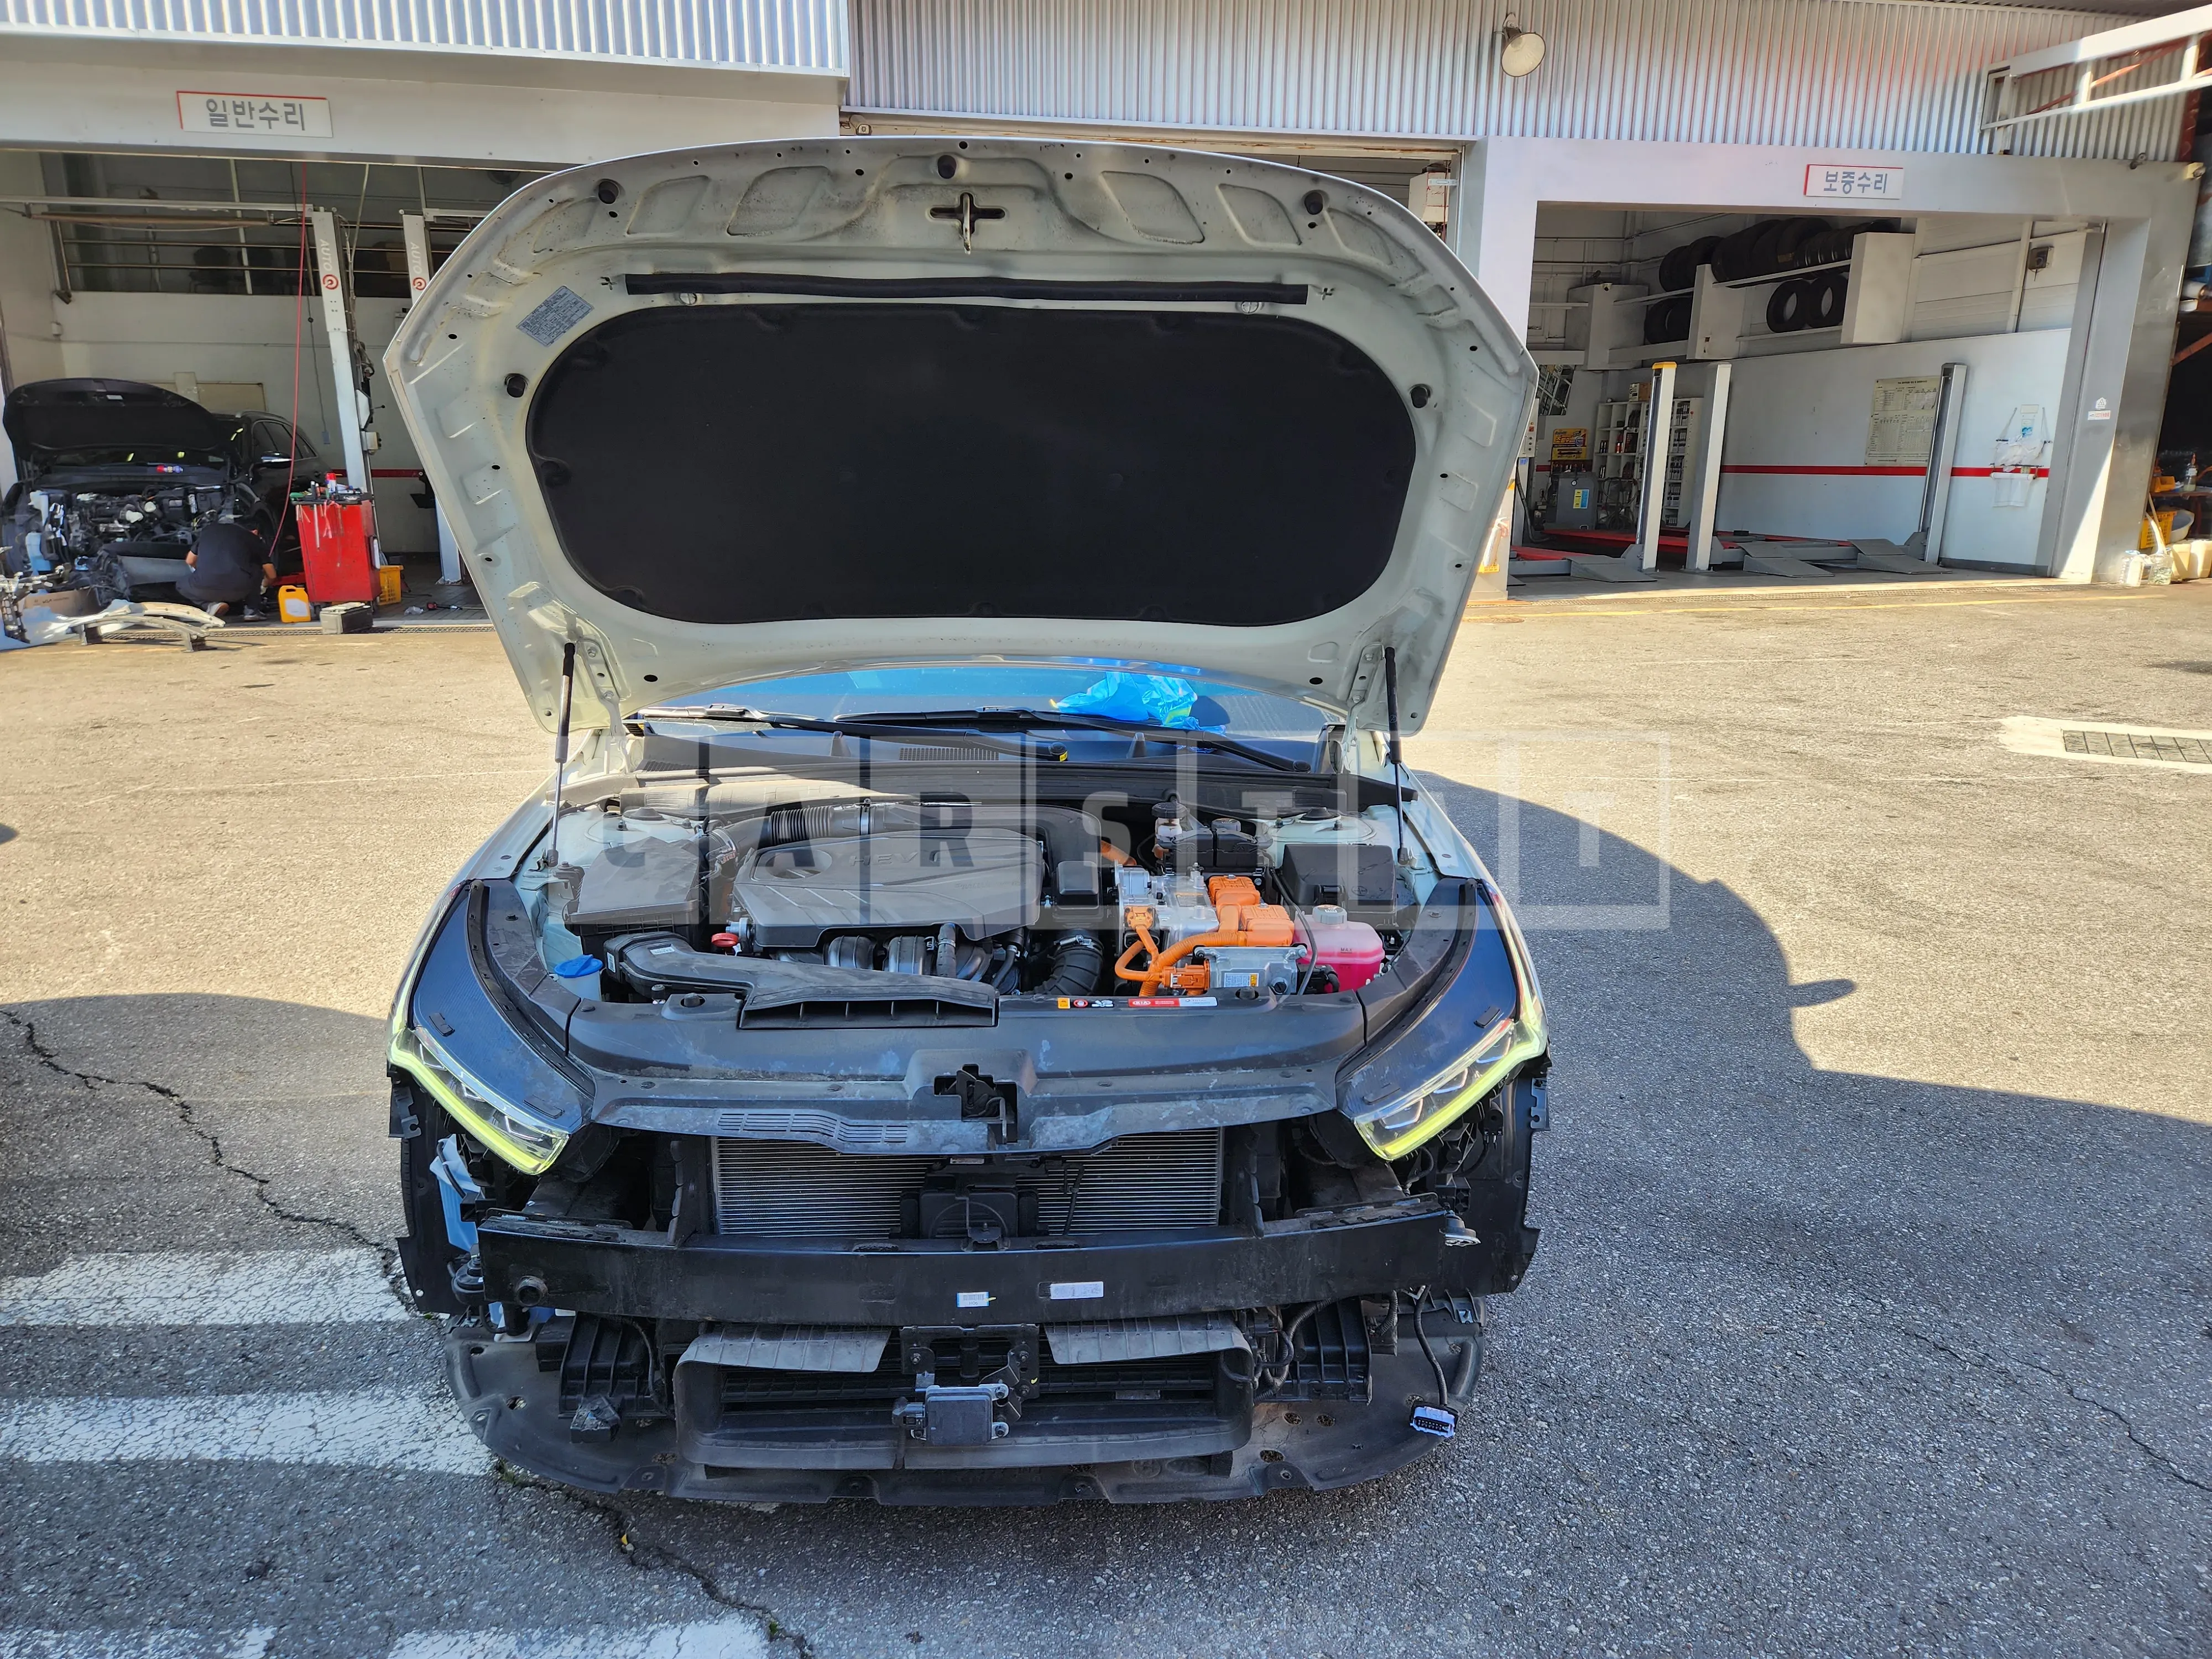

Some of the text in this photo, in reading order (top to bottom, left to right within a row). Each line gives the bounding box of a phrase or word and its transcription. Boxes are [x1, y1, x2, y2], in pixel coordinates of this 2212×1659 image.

[206, 98, 305, 131] 일반수리
[1824, 171, 1887, 194] 보증수리
[320, 239, 332, 272] AUTO
[410, 242, 422, 274] AUTO
[849, 852, 919, 866] HEV
